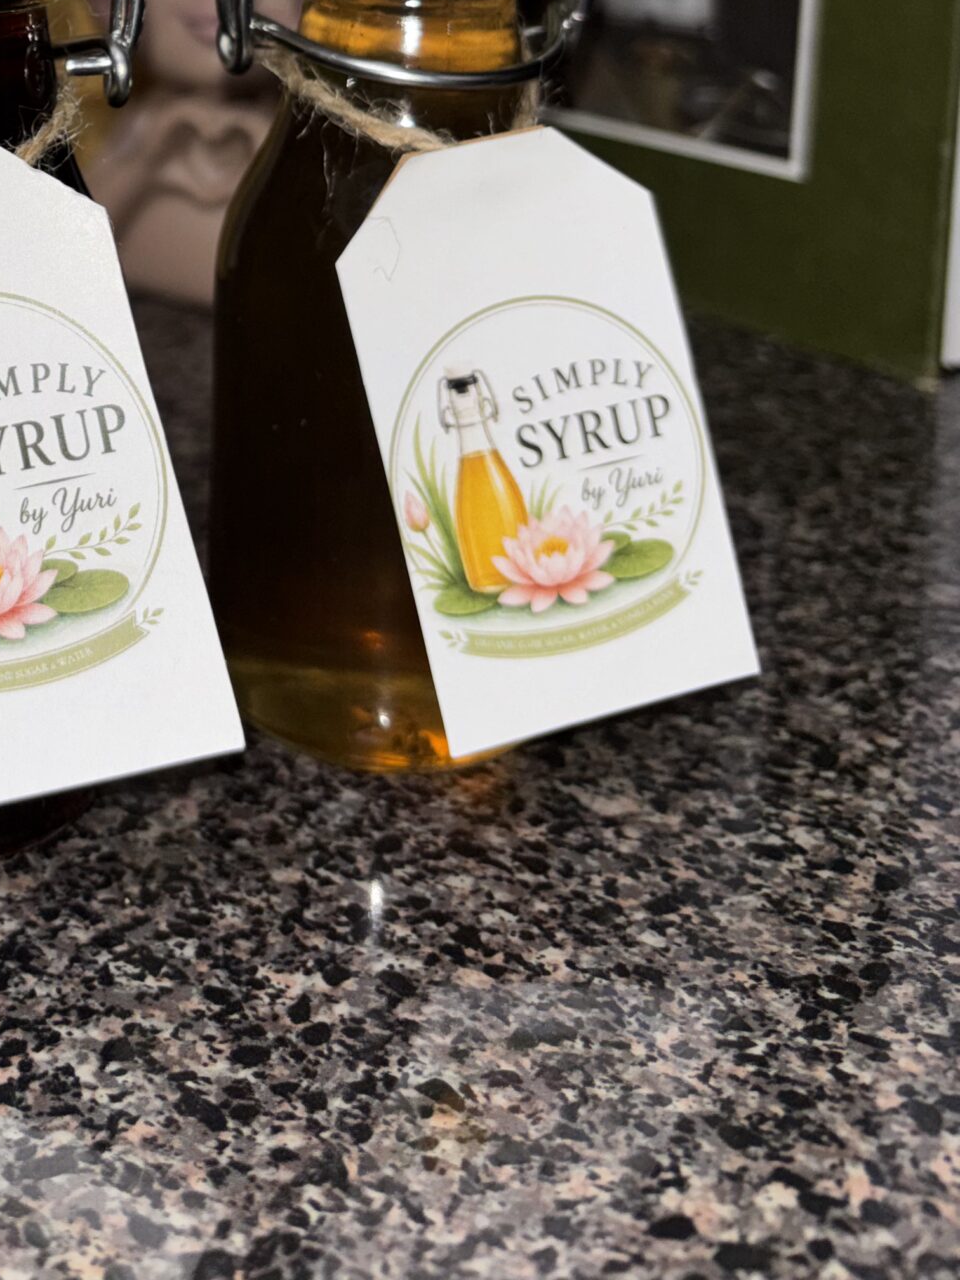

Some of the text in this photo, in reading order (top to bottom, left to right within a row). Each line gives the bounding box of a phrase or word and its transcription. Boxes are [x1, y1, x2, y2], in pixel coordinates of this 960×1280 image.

[512, 358, 655, 415] SIMPLY
[516, 393, 671, 468] SYRUP
[19, 487, 118, 535] by Yuri
[581, 467, 664, 510] by Yuri
